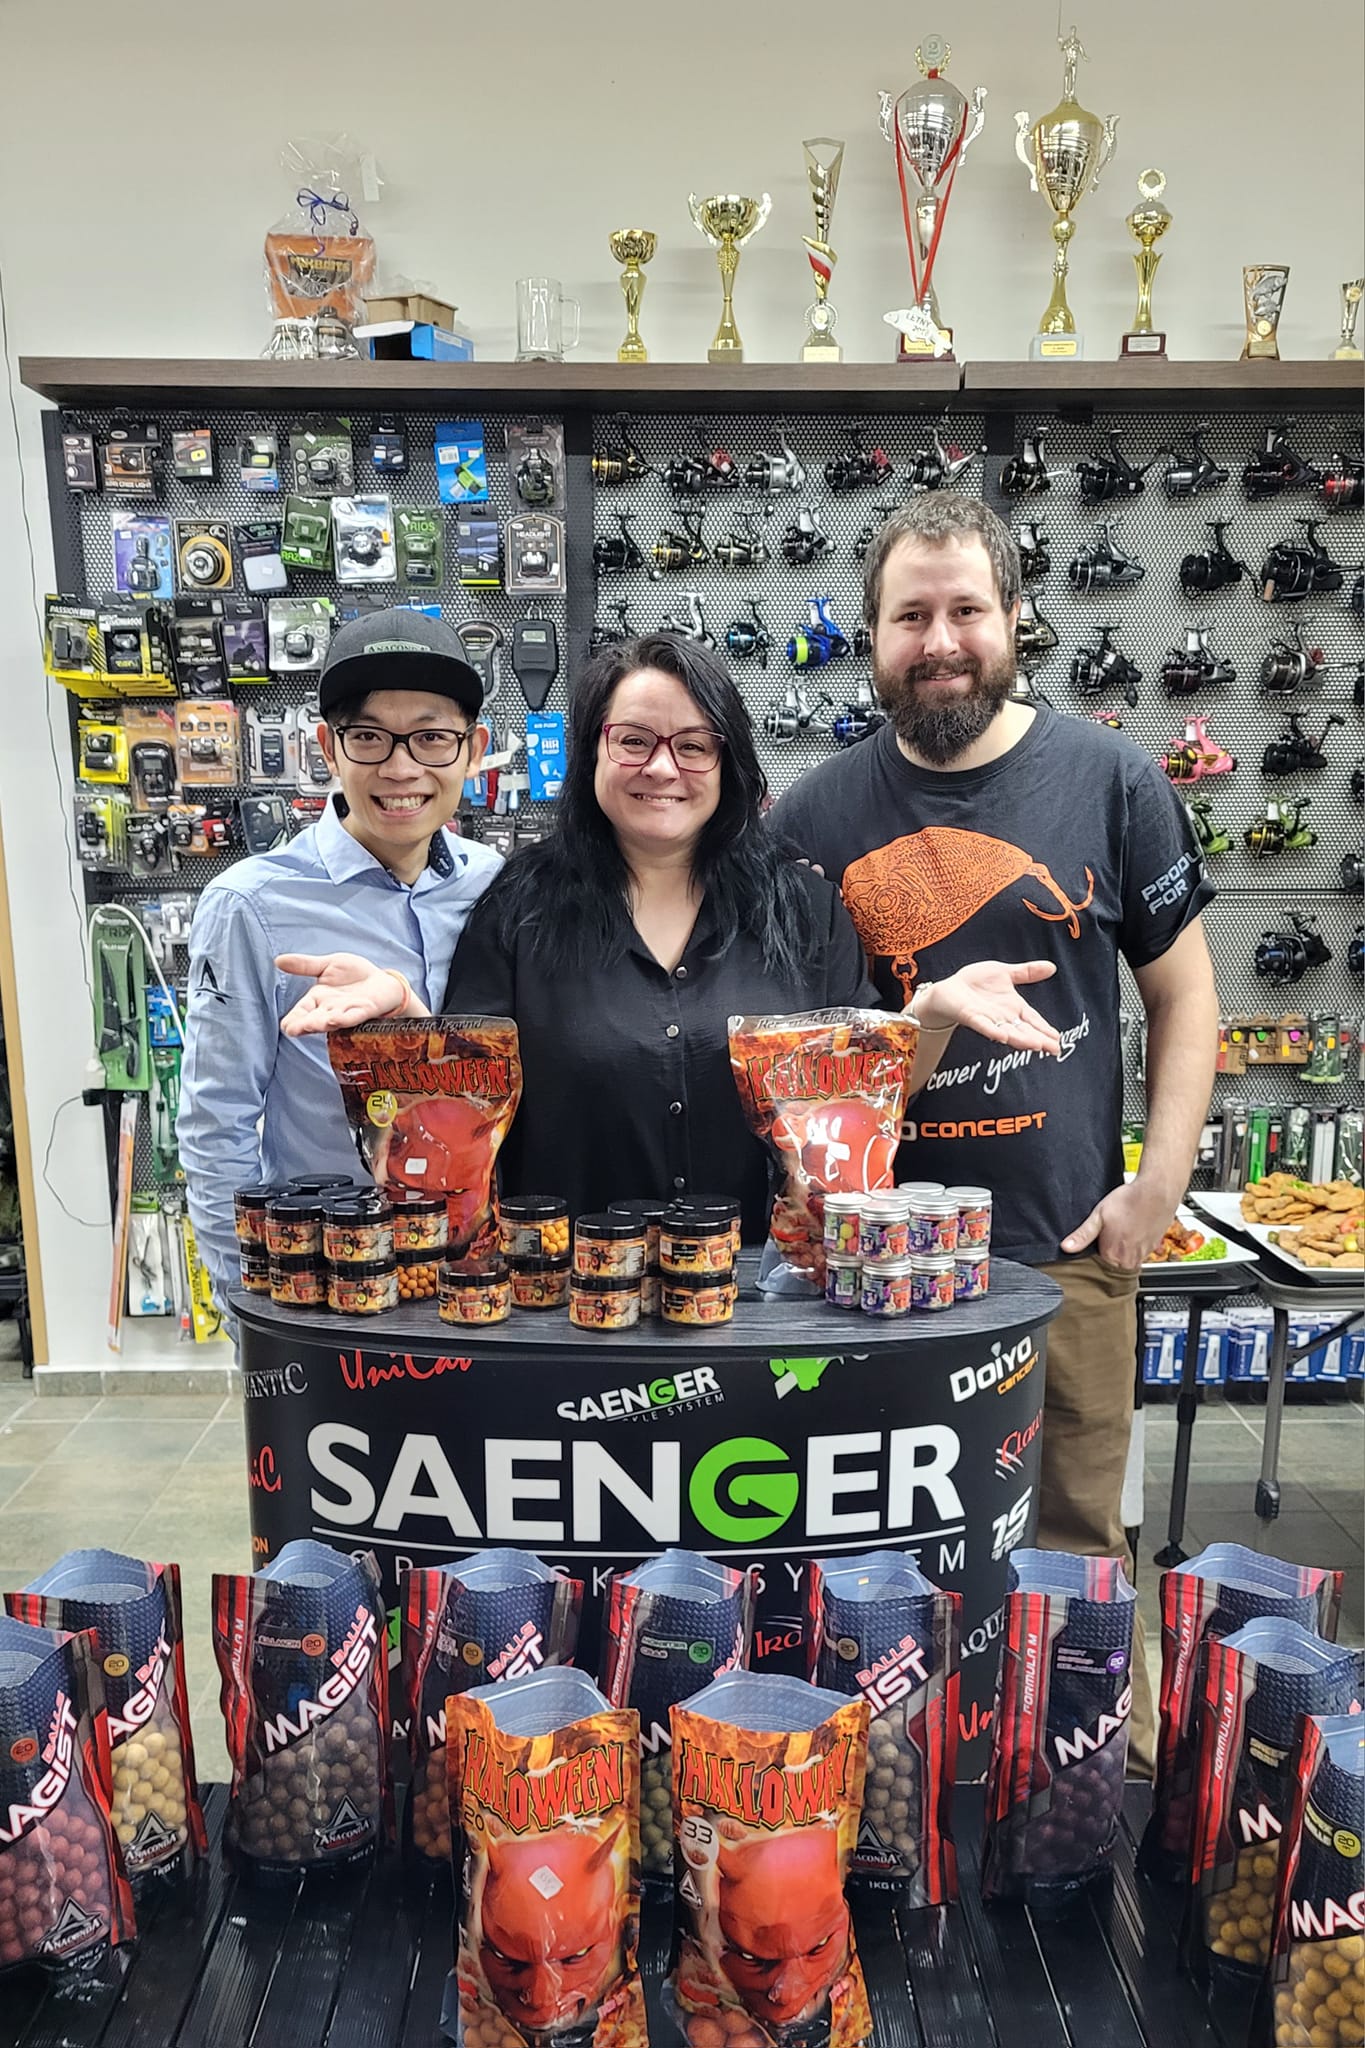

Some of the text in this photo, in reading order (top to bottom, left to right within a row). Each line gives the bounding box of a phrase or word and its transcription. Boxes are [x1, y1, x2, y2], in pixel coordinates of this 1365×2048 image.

[928, 41, 939, 55] 2
[905, 312, 932, 328] LETNY
[1148, 878, 1188, 915] FOR
[353, 1021, 397, 1033] Return
[400, 1019, 413, 1032] of
[439, 1018, 483, 1034] Legend
[345, 1057, 511, 1097] HALLOWEEN
[748, 1052, 906, 1101] HALLOWEEN
[920, 1111, 1047, 1139] CONCEPT
[997, 1351, 1040, 1396] CONCEPT
[556, 1365, 722, 1422] SAENGER
[667, 1392, 725, 1417] SYSTEM
[306, 1421, 966, 1544] SAENGER
[305, 1639, 322, 1648] 20
[330, 1604, 369, 1669] BALLS
[487, 1621, 538, 1679] BALLS
[109, 1659, 125, 1669] 20
[855, 1633, 917, 1688] BALLS
[1022, 1632, 1039, 1716] FORMULA M
[1174, 1625, 1192, 1695] FORMULA
[264, 1613, 378, 1753] MAGIST
[1214, 1691, 1235, 1780] FORMULA M
[464, 1803, 485, 1832] 20
[683, 1818, 713, 1846] 33
[125, 1831, 178, 1861] ANACONDA
[1337, 1834, 1356, 1848] 20
[43, 1918, 101, 1953] ANACONDA
